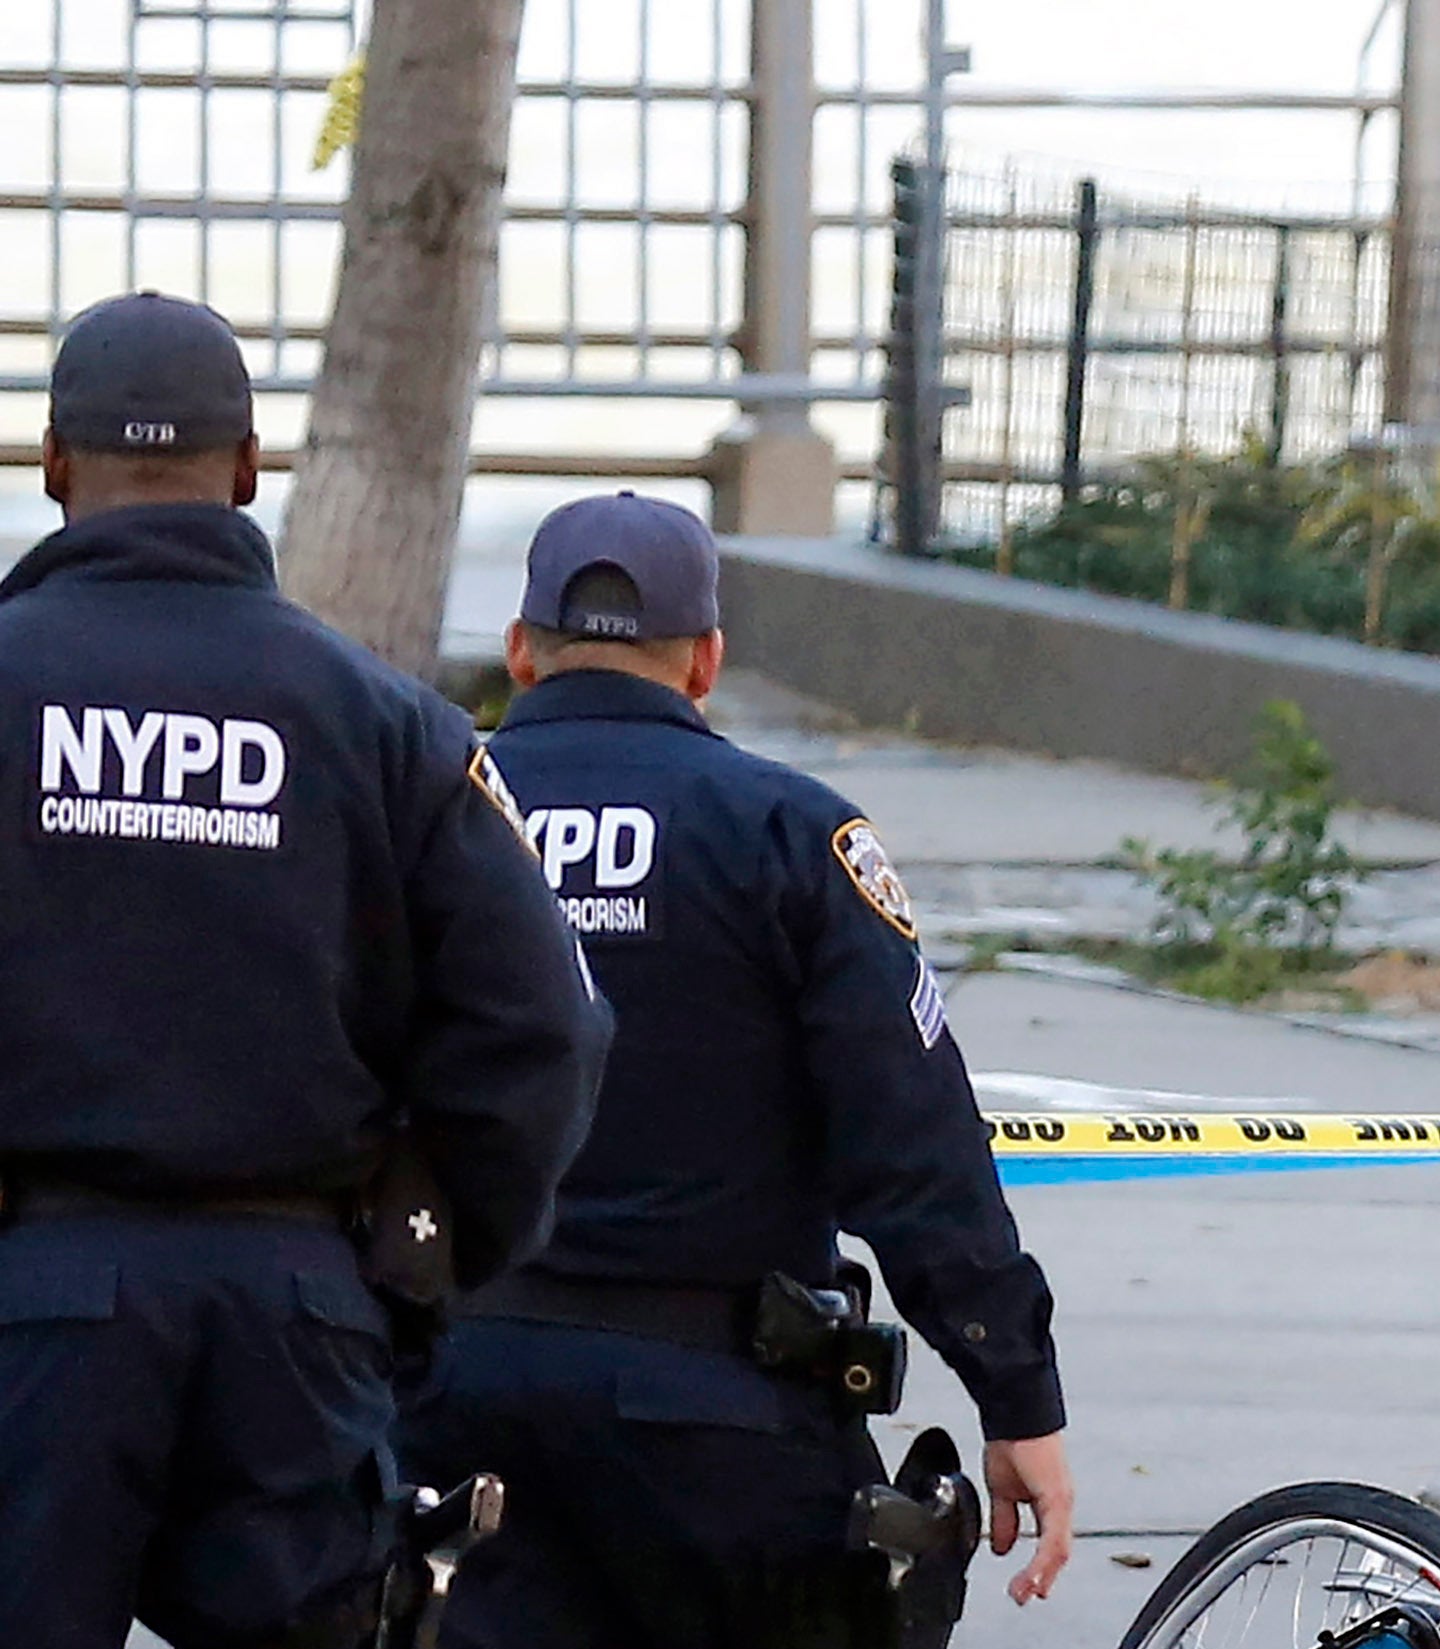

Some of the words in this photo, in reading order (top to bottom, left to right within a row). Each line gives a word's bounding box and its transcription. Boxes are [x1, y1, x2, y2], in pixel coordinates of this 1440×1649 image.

[41, 704, 286, 807] NYPD
[41, 796, 281, 850] COUNTERTERRORISM
[525, 807, 656, 889] PD
